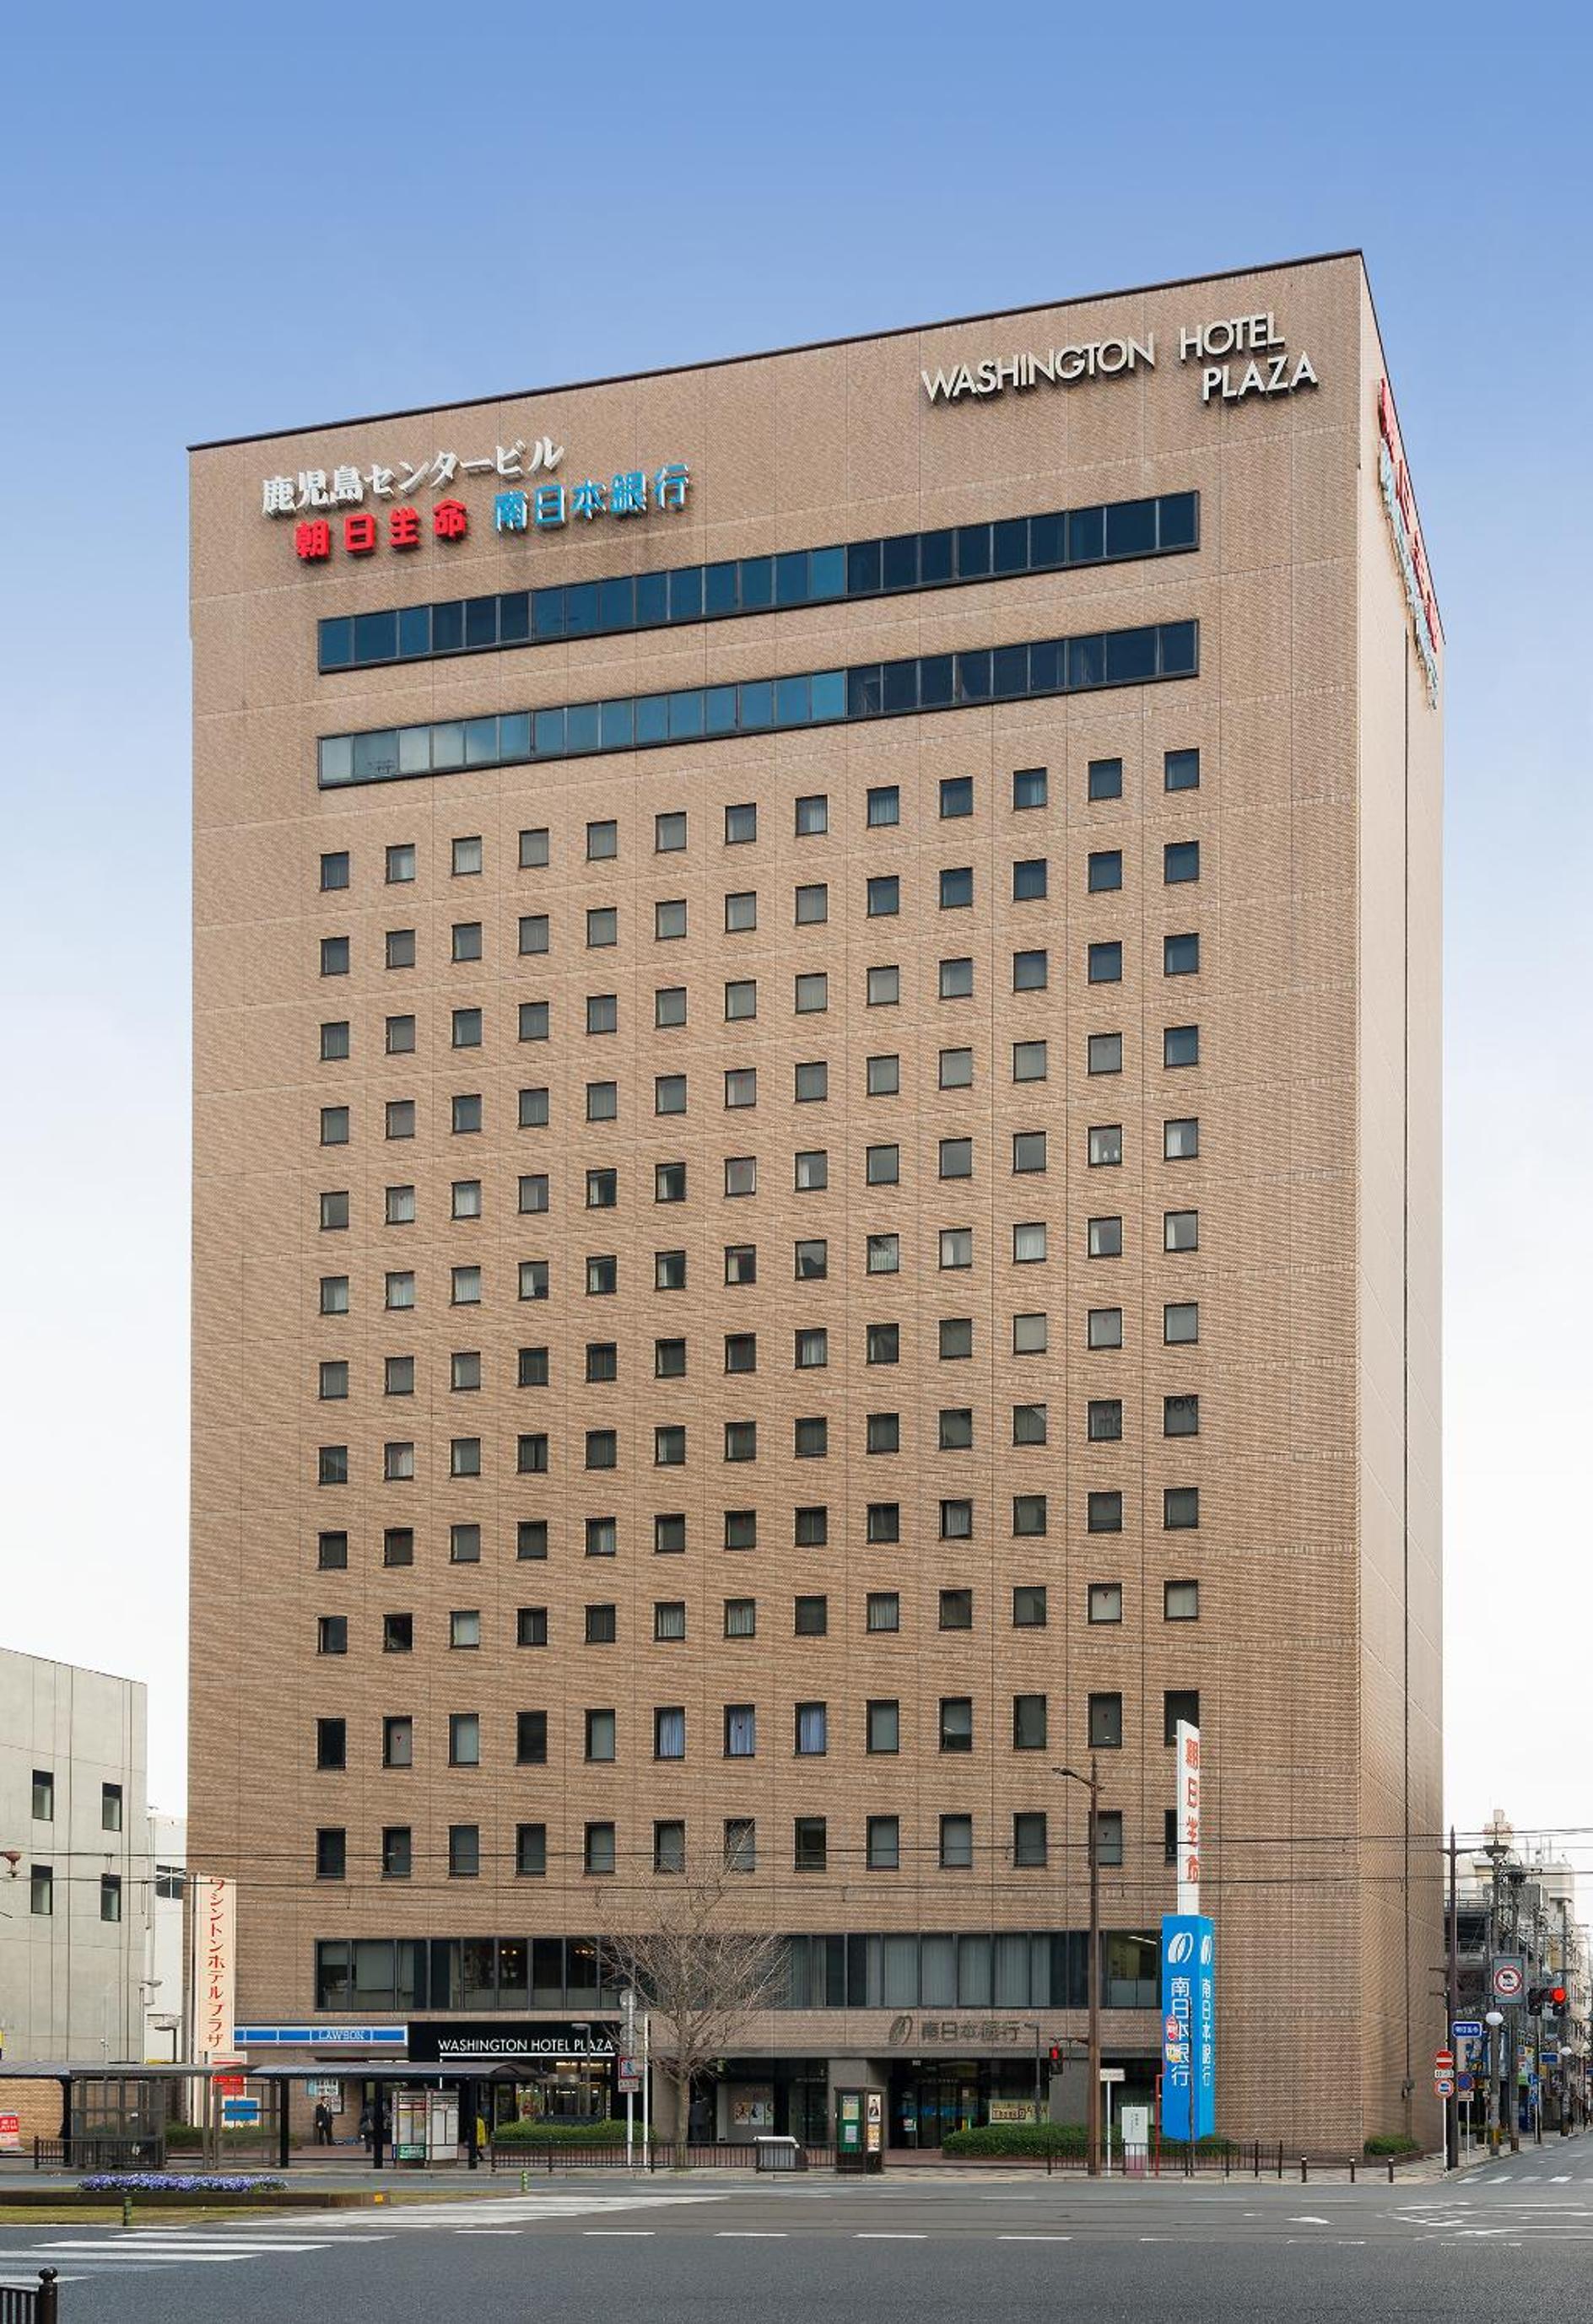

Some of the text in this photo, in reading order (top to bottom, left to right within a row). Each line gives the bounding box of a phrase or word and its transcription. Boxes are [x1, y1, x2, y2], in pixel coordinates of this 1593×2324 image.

[921, 312, 1284, 401] WASHINGTON HOTEL
[1202, 351, 1319, 407] PLAZA
[261, 435, 565, 516] 鹿児島センタービル
[492, 463, 690, 535] 南日本銀行
[294, 498, 469, 560] 朝日生命
[318, 2030, 365, 2040] LAWSON
[438, 2039, 613, 2052] WASHINGTON HOTEL PLAZA
